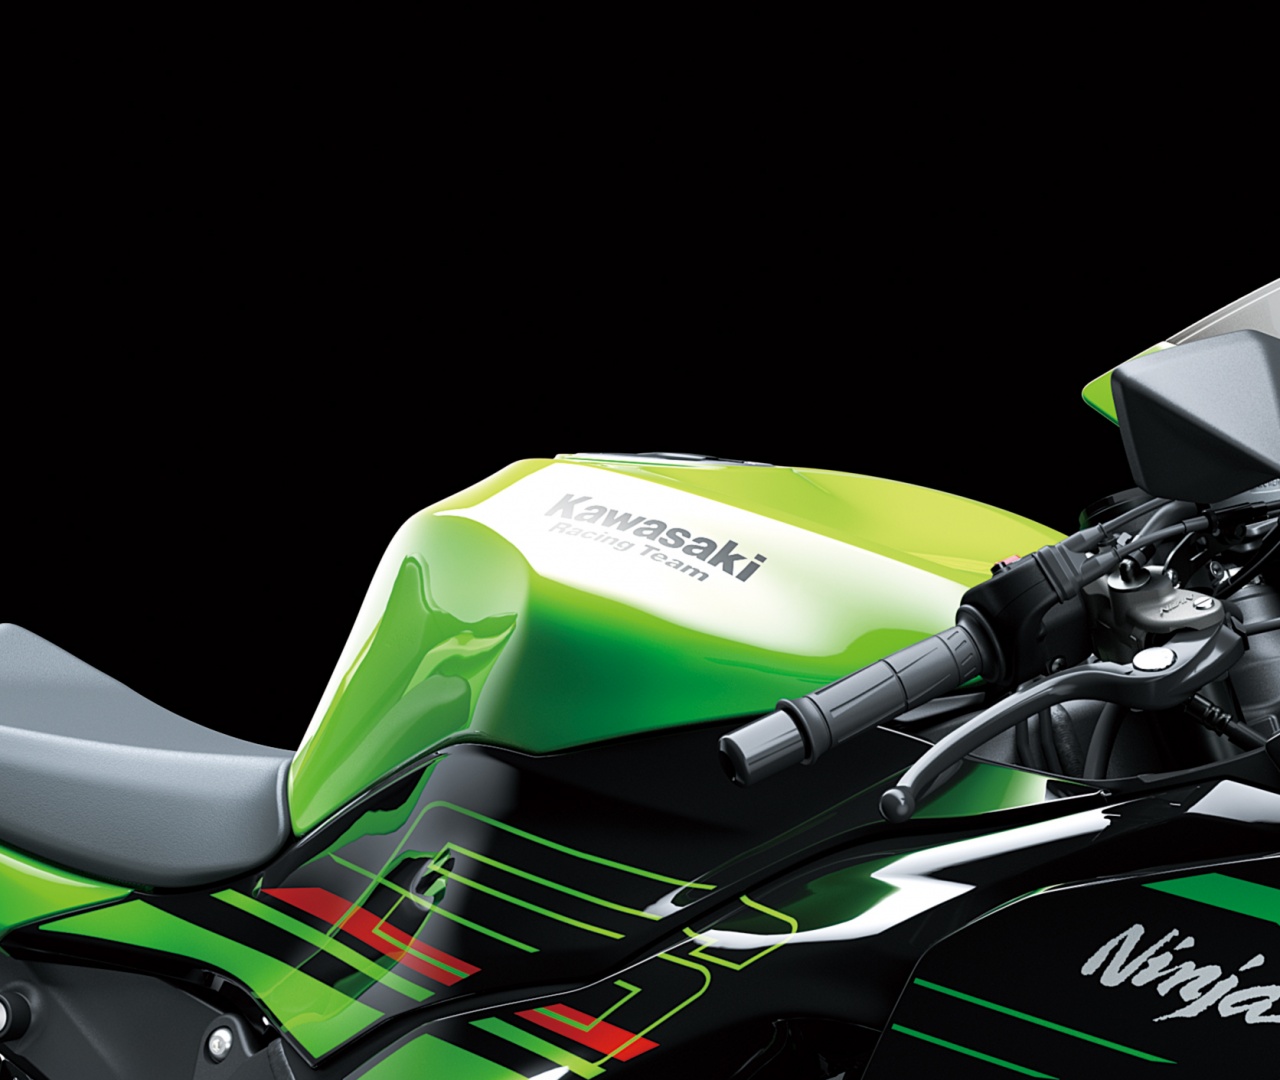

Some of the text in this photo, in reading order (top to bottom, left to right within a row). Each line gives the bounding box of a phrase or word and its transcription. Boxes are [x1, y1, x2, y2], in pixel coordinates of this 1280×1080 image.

[544, 493, 767, 582] Kawasaki
[548, 521, 709, 581] Racing Team
